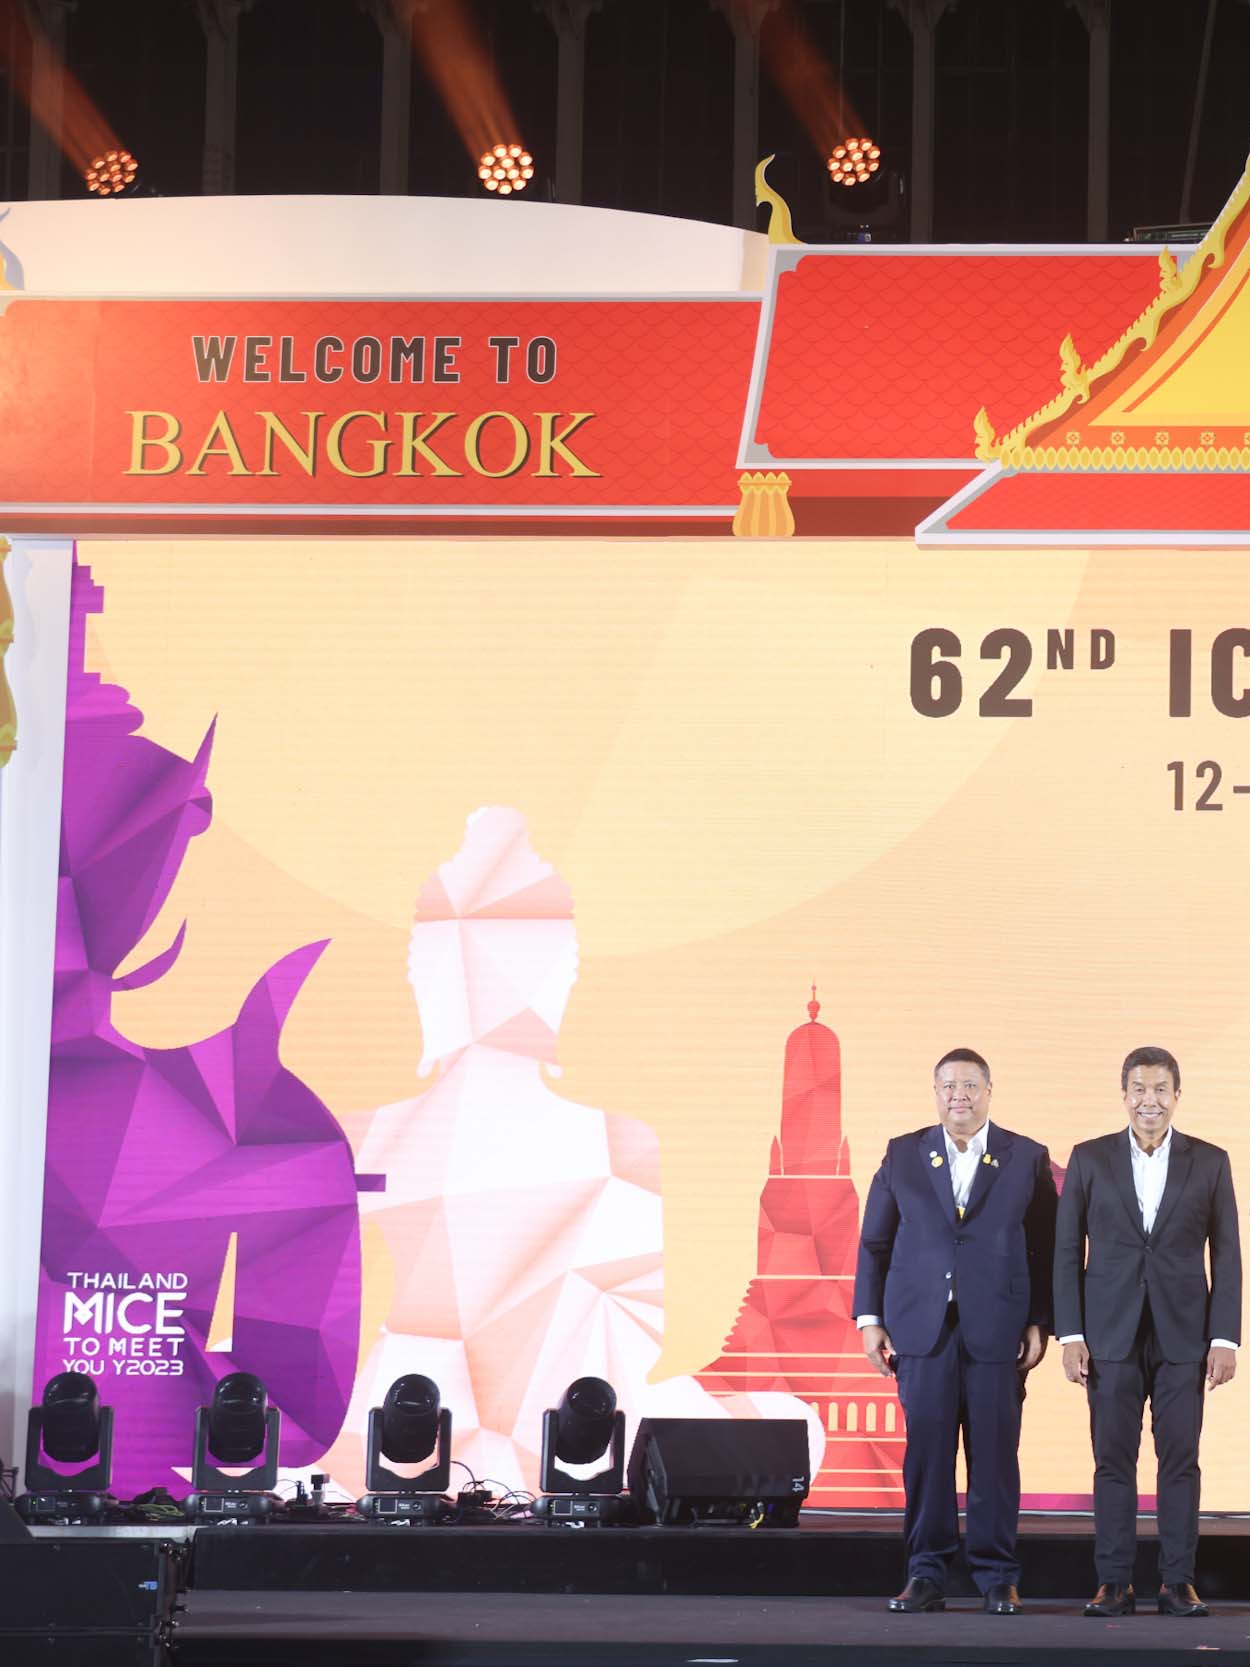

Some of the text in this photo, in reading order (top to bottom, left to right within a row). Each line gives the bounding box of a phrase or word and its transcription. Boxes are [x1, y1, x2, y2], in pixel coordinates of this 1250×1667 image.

[191, 335, 557, 384] WELCOME TO
[123, 410, 603, 479] BANGKOK
[910, 627, 1116, 718] 62ND
[66, 1272, 188, 1289] THAILAND
[63, 1291, 187, 1335] MICE
[63, 1337, 185, 1357] TO MEET
[62, 1359, 184, 1376] YOU Y2023
[791, 1475, 805, 1493] 14
